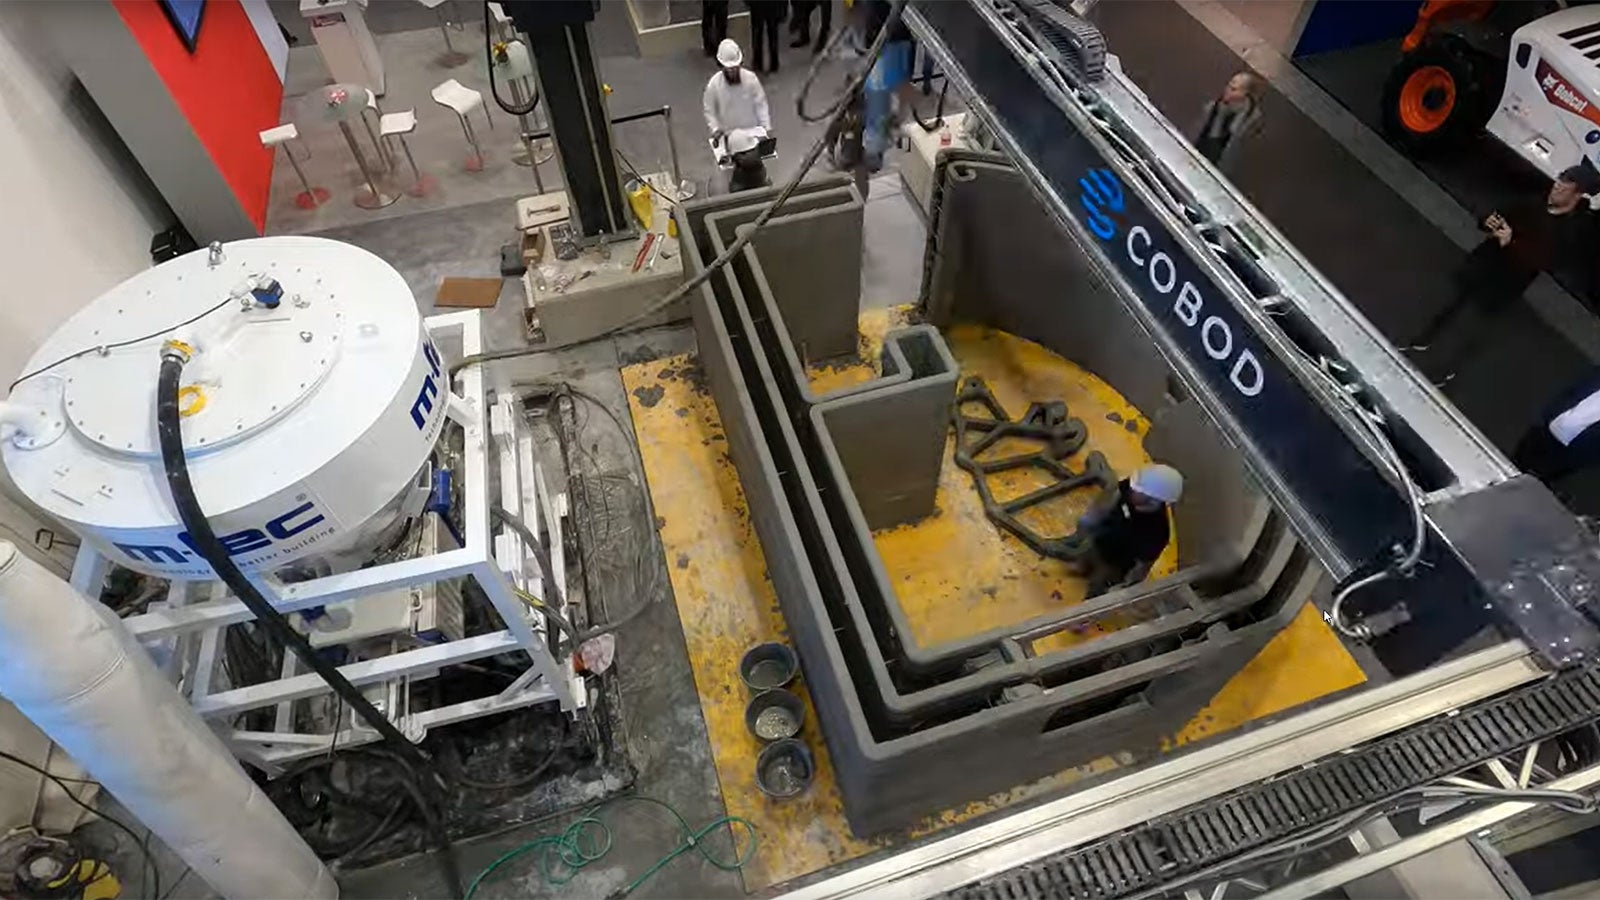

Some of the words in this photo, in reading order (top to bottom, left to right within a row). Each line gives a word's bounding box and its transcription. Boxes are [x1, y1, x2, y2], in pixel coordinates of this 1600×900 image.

[1554, 84, 1588, 112] Bobcat
[1127, 225, 1264, 396] COBOD
[282, 526, 335, 553] building
